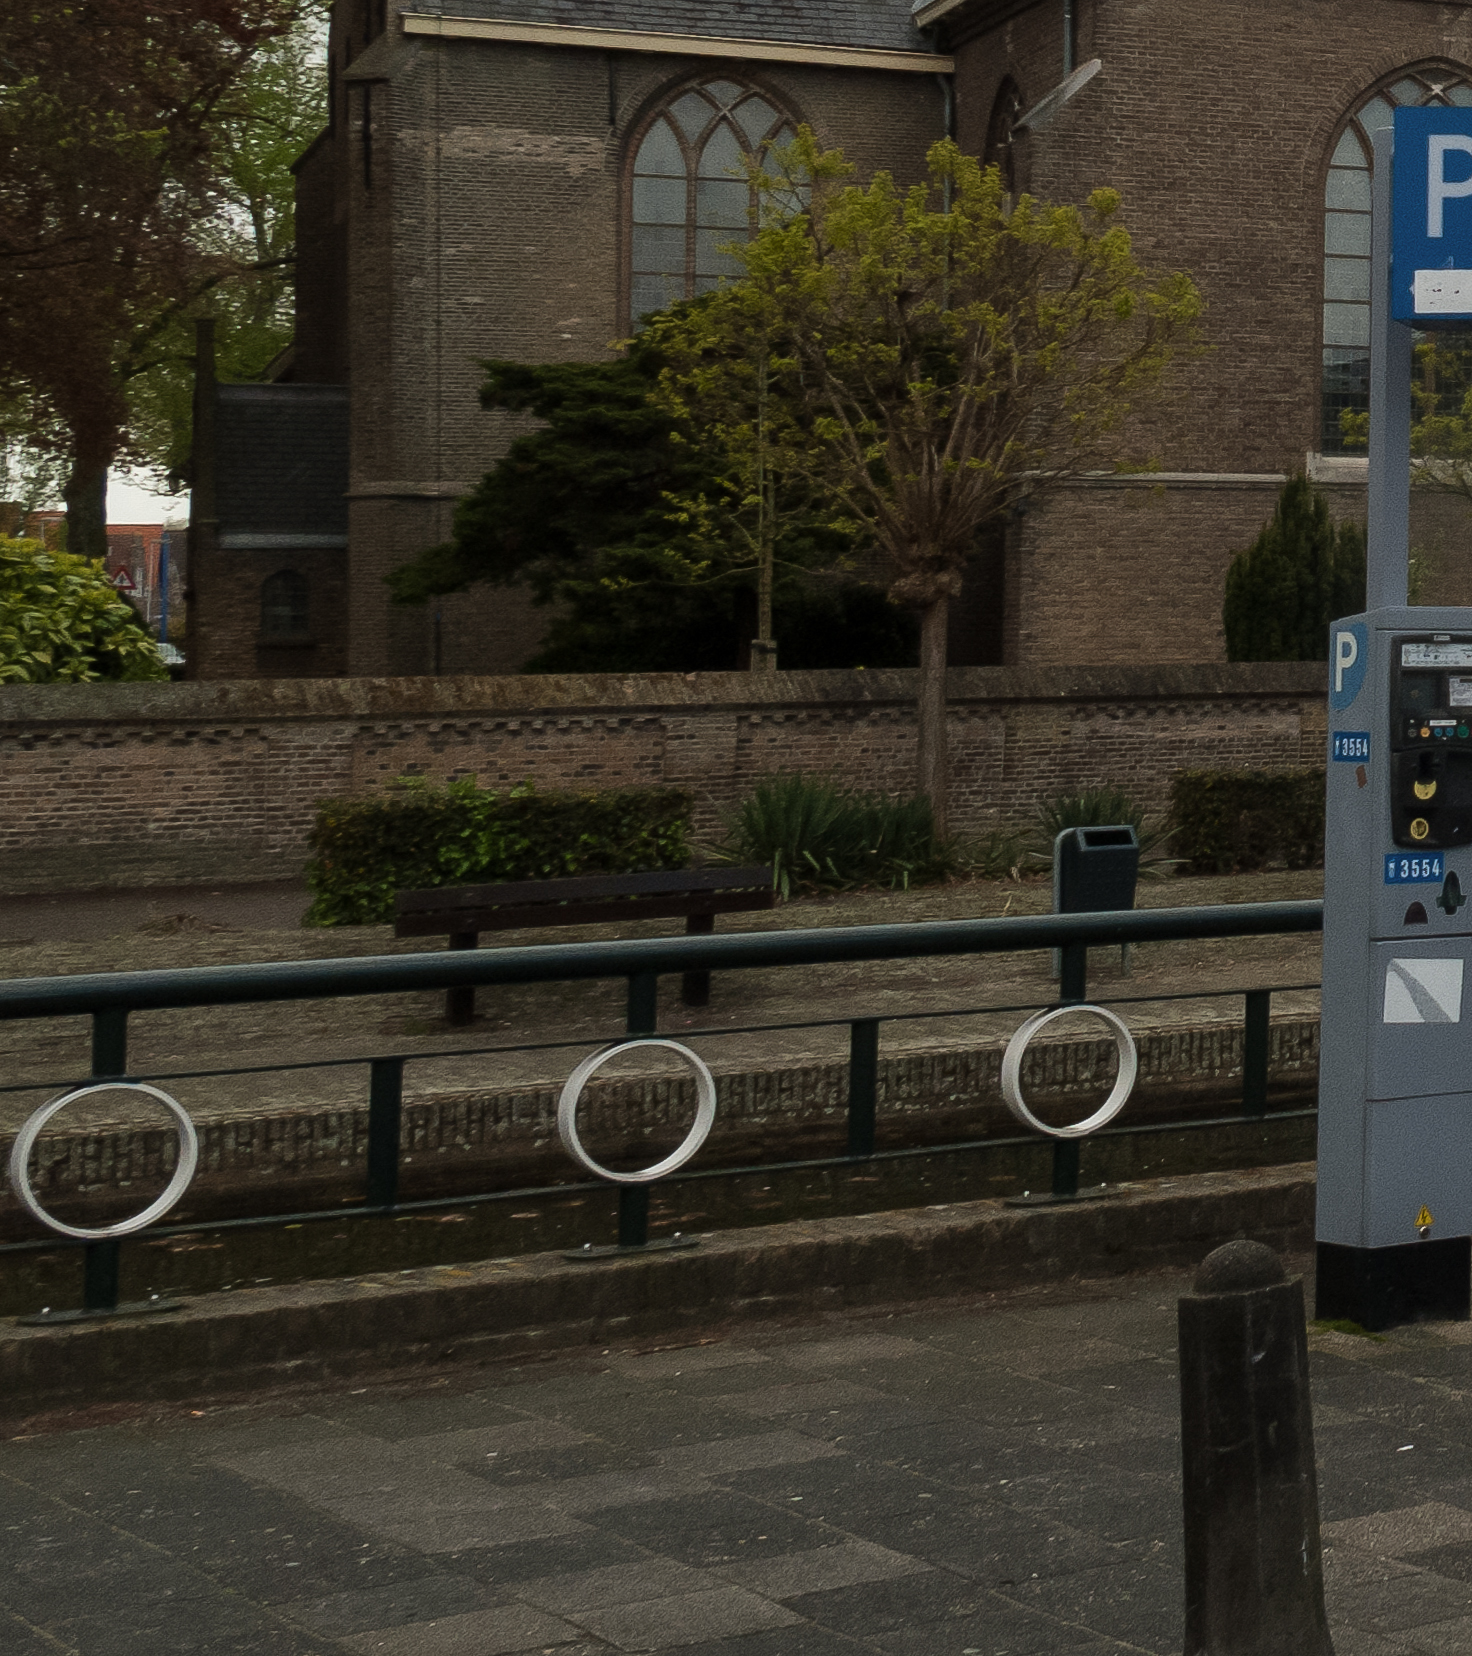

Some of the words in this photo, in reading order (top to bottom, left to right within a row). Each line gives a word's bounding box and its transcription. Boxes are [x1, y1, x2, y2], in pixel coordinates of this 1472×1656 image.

[1334, 631, 1358, 693] P
[1342, 738, 1369, 757] 3554
[1400, 858, 1441, 879] 3554
